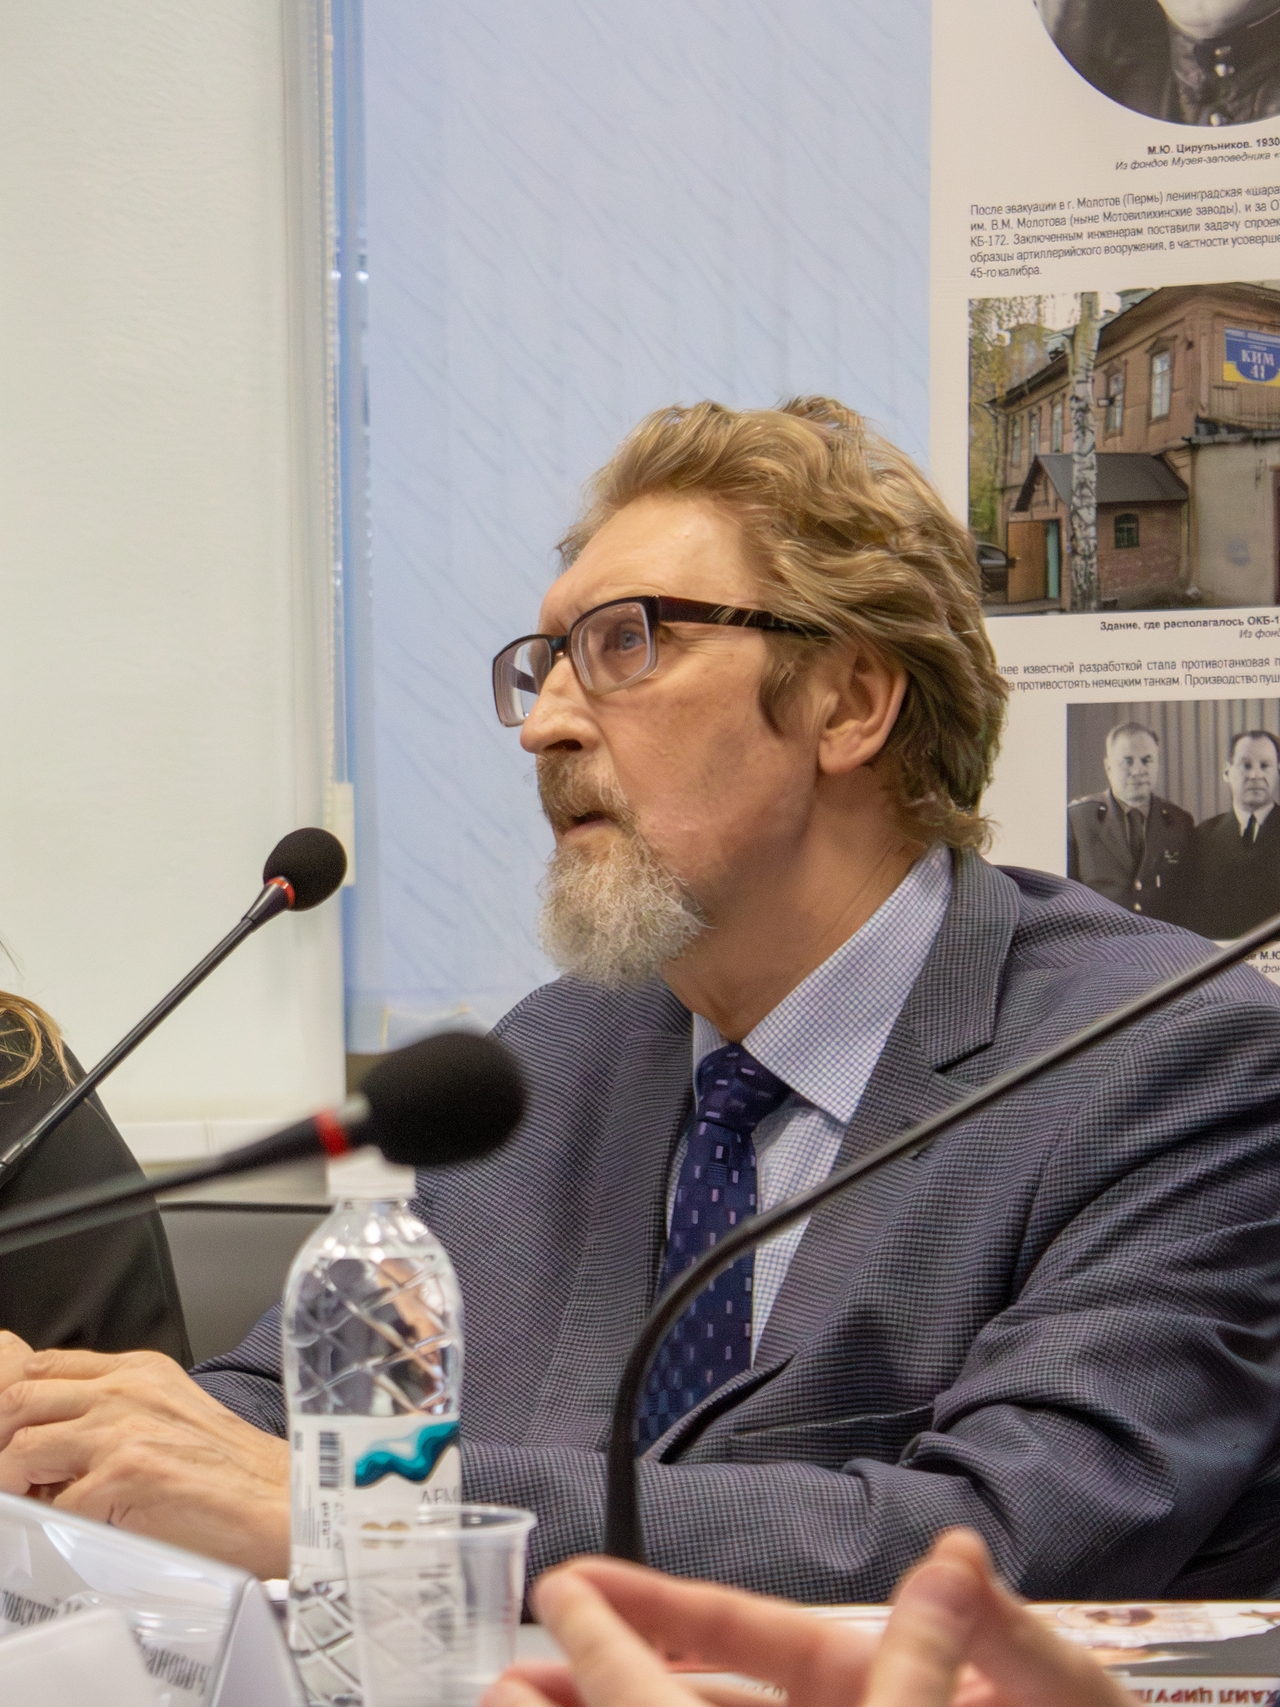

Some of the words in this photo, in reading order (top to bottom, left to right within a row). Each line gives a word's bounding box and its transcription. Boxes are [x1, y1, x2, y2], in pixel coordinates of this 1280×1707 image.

[1115, 161, 1128, 170] Из
[1130, 158, 1168, 170] фондов
[1171, 152, 1271, 168] Музея-заповедника
[970, 204, 1003, 216] После
[1005, 202, 1057, 214] эвакуации
[1059, 201, 1065, 210] в
[1067, 200, 1075, 210] г.
[1076, 196, 1121, 209] Молотов
[1123, 191, 1163, 208] (Пермь)
[1165, 187, 1242, 203] ленинградская
[970, 222, 988, 231] им.
[991, 218, 1014, 231] В.М.
[1017, 216, 1067, 229] Молотова
[1070, 213, 1100, 227] (ныне
[1103, 206, 1193, 223] Мотовилихинские
[1245, 203, 1252, 213] и
[1255, 202, 1267, 212] за
[970, 234, 1010, 247] КБ-172.
[1013, 230, 1084, 245] Заключенным
[1087, 225, 1144, 240] инженерам
[1147, 222, 1201, 236] поставили
[1204, 219, 1241, 232] задачу
[970, 251, 1015, 265] образцы
[1017, 245, 1102, 262] артиллерийского
[1104, 240, 1167, 256] вооружения,
[1169, 240, 1176, 250] в
[1177, 236, 1229, 249] частности
[970, 267, 997, 278] 45-го
[998, 264, 1042, 279] калибра.
[1144, 620, 1161, 630] где
[1164, 617, 1245, 630] располагалось
[1239, 629, 1253, 639] Из
[1023, 661, 1075, 675] известной
[1079, 660, 1142, 675] разработкой
[1146, 660, 1177, 671] стала
[1181, 657, 1270, 672] противотанковая
[1017, 679, 1090, 693] противостоять
[1092, 678, 1141, 690] немецким
[1184, 673, 1258, 688] Производство
